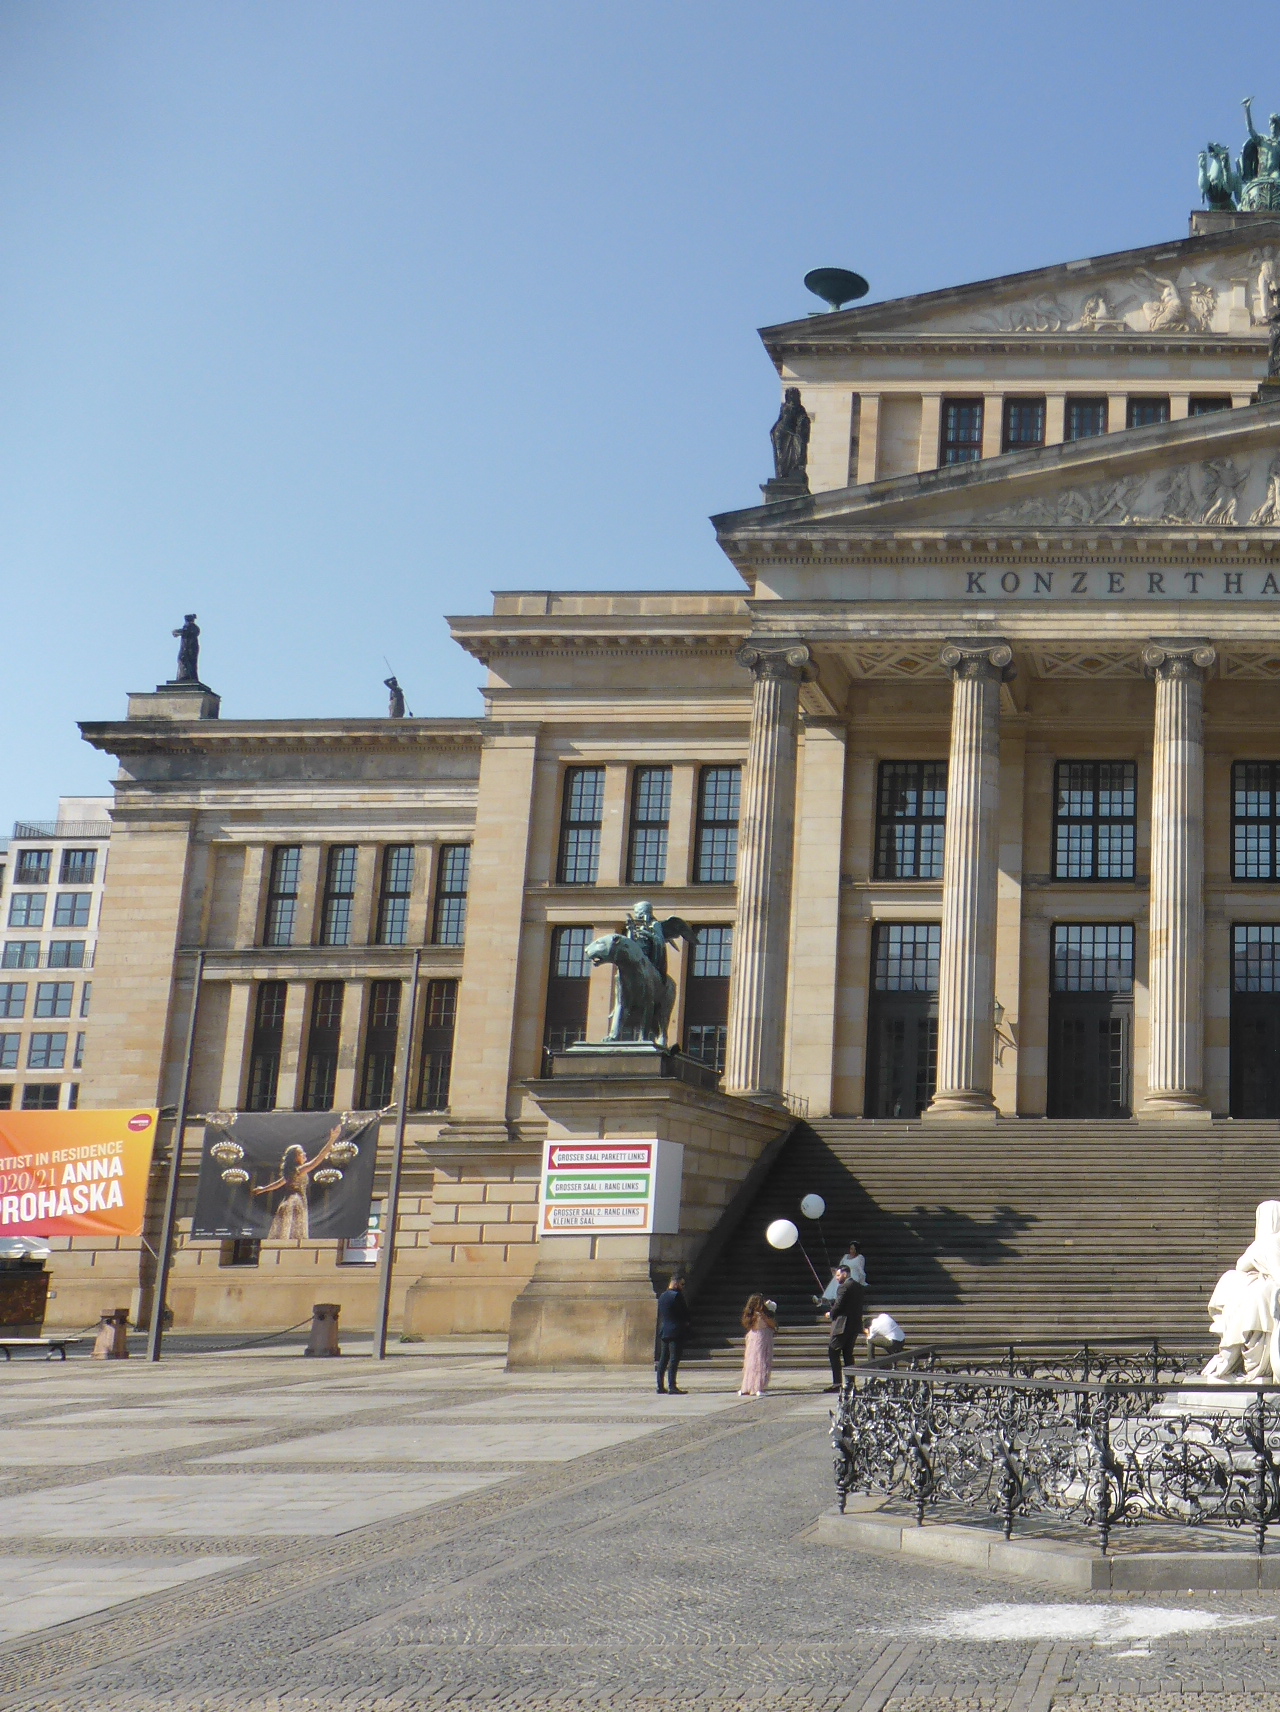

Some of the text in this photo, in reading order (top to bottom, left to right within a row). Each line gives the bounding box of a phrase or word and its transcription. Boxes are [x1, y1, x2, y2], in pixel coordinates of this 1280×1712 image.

[35, 1152, 49, 1166] IN
[52, 1140, 124, 1164] RESIDENCE
[558, 1152, 645, 1161] GROSSER SAAL PARKETT LINKS
[61, 1156, 124, 1185] ANNA
[556, 1183, 582, 1191] GROSSER
[583, 1183, 598, 1191] SAAL
[622, 1182, 639, 1190] LINKS
[0, 1179, 124, 1225] ROHASKA
[554, 1208, 580, 1216] GROSSER
